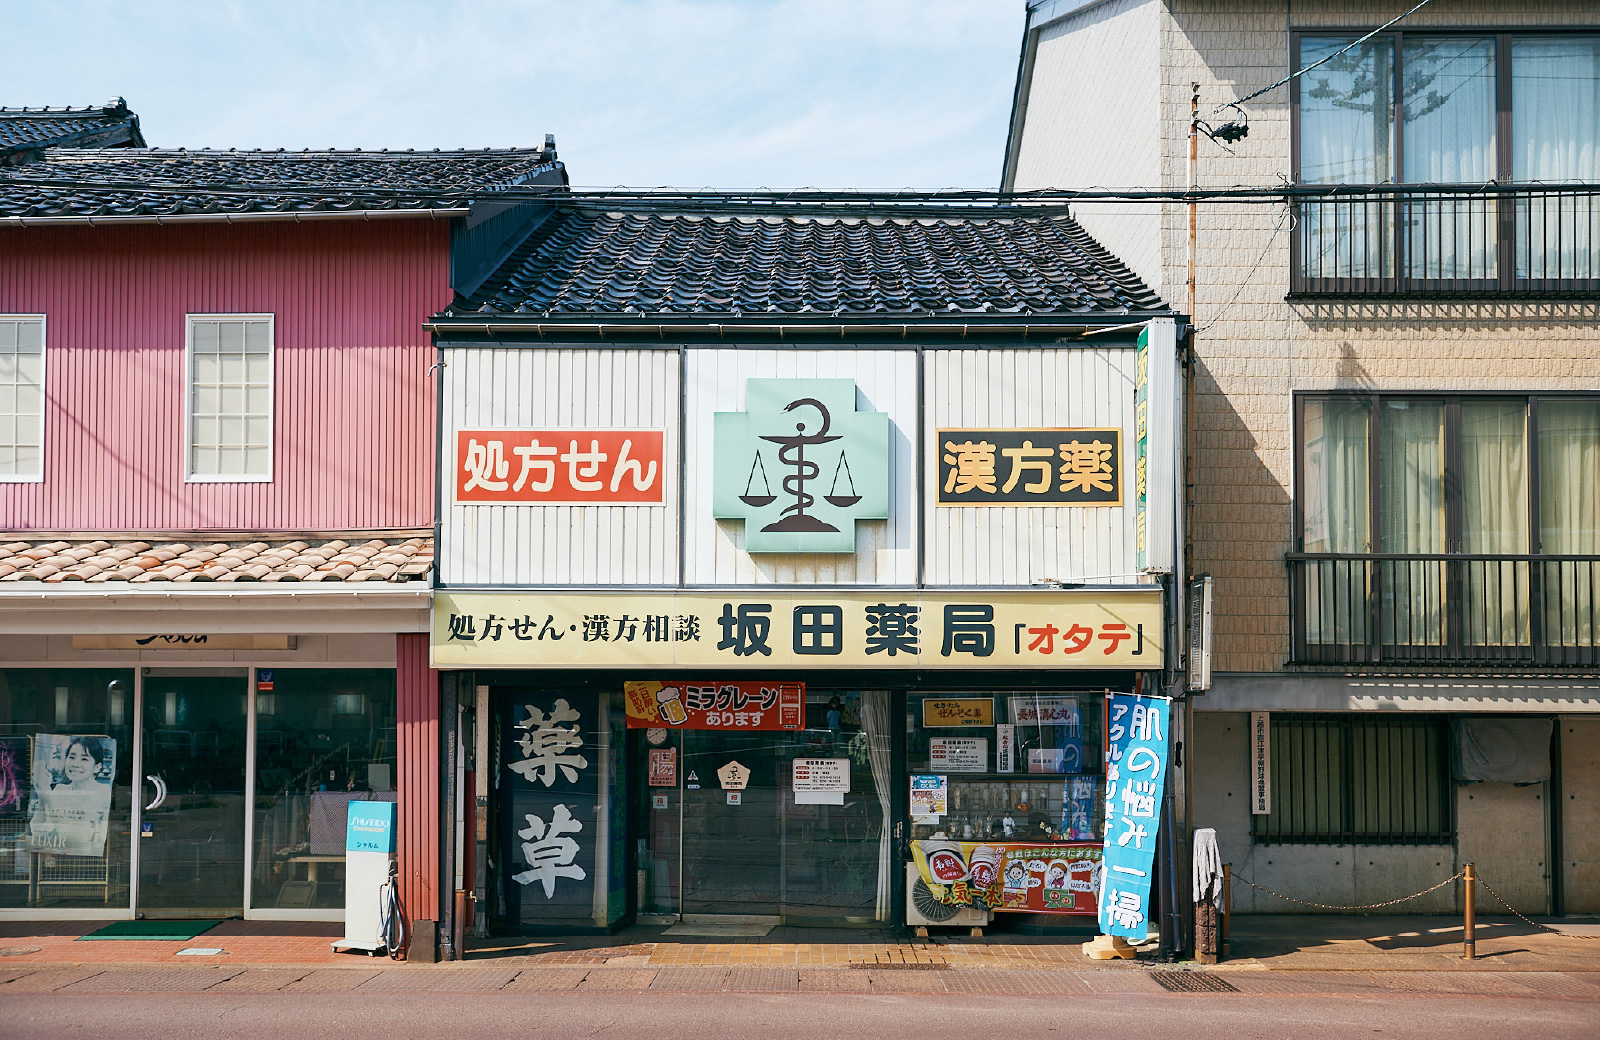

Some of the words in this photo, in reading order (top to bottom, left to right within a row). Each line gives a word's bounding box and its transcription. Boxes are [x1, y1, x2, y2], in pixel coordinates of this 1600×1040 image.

[464, 438, 657, 493] 処方せん
[942, 440, 1114, 495] 漢方薬
[446, 613, 702, 643] 処方せん・漢方相談
[716, 602, 996, 657] 坂田薬局
[686, 685, 779, 711] ミラグレーン
[705, 711, 764, 727] あります
[350, 816, 390, 828] SHISEIDO
[507, 697, 588, 900] 薬草
[1106, 703, 1164, 930] 肌の悩み一掃
[356, 841, 379, 849] シャルム
